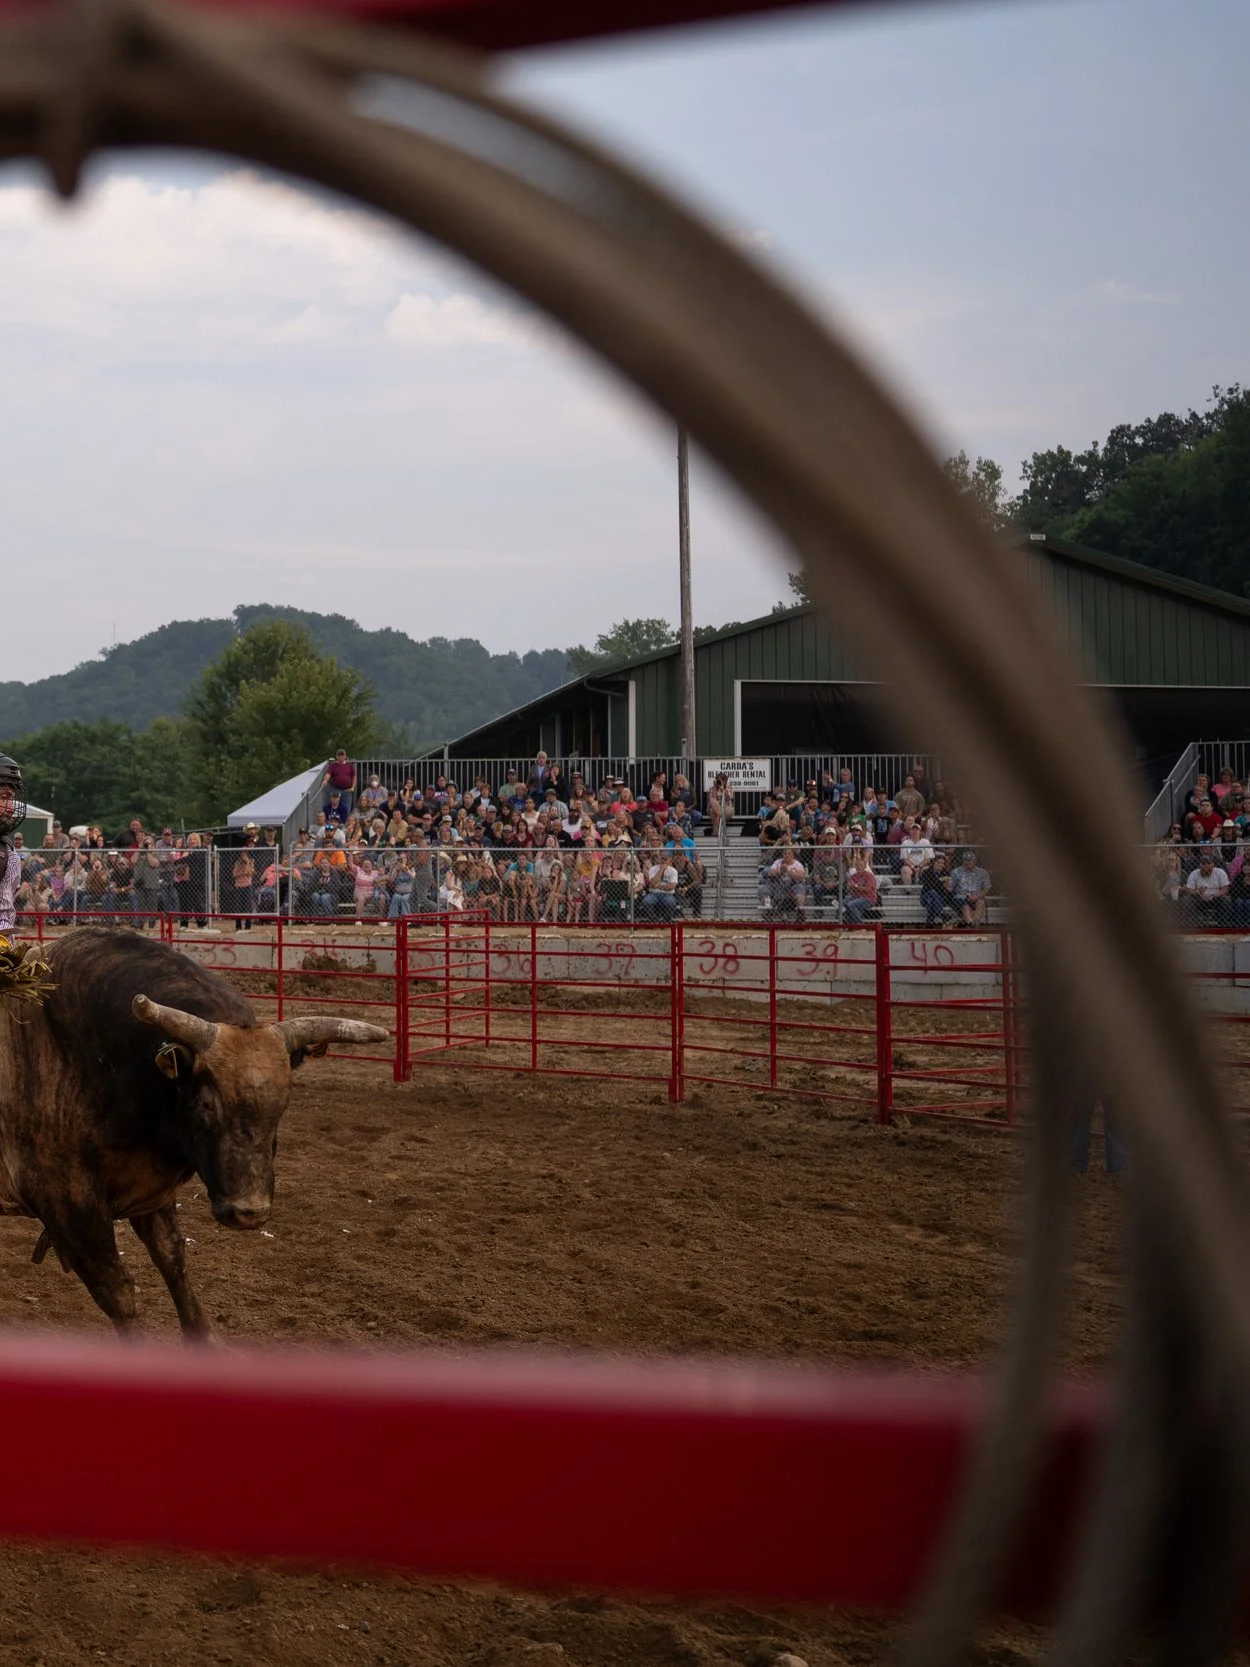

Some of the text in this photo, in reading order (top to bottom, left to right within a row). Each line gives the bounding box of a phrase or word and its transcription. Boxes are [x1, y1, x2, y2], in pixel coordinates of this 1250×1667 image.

[698, 939, 740, 976] 38
[796, 942, 839, 978] 39
[909, 940, 955, 974] 40
